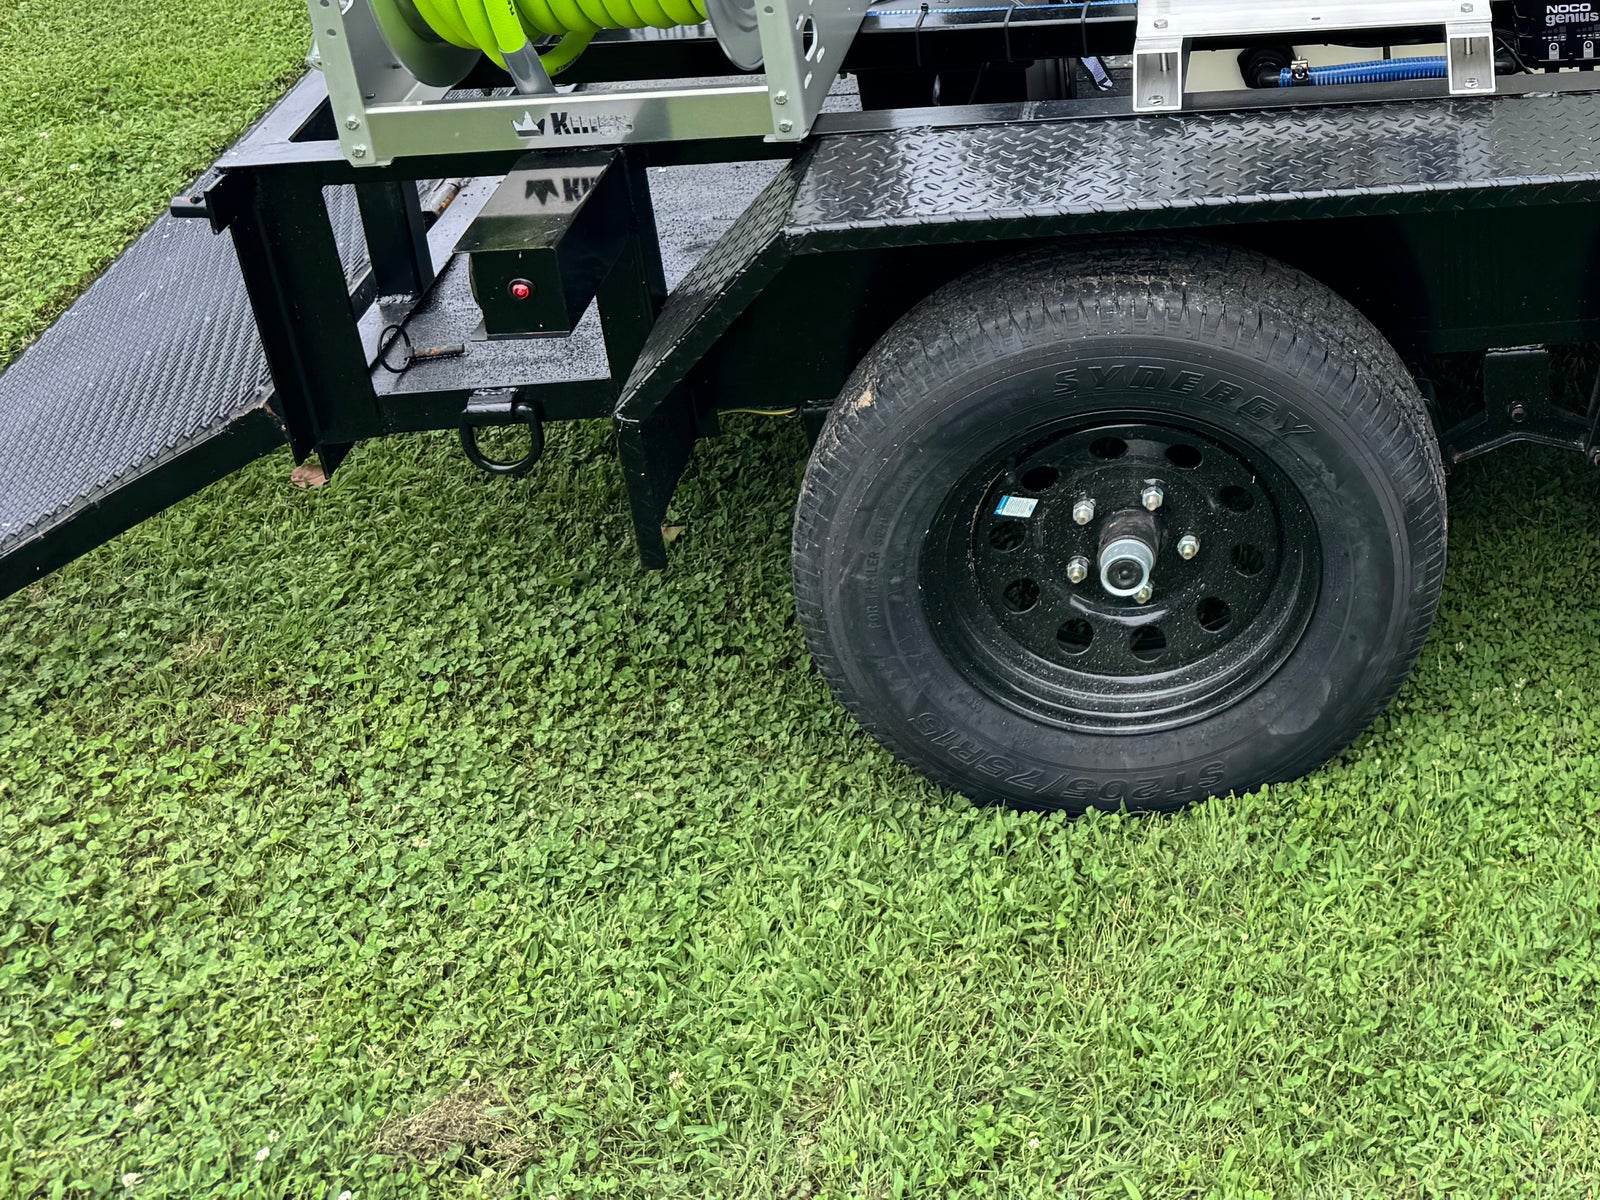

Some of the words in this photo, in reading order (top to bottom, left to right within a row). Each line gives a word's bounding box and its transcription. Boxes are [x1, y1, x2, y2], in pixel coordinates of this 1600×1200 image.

[1545, 11, 1599, 27] genius
[1546, 3, 1591, 14] NOCO
[1053, 364, 1316, 436] SYNERGY
[907, 712, 1226, 801] ST205/75R15
